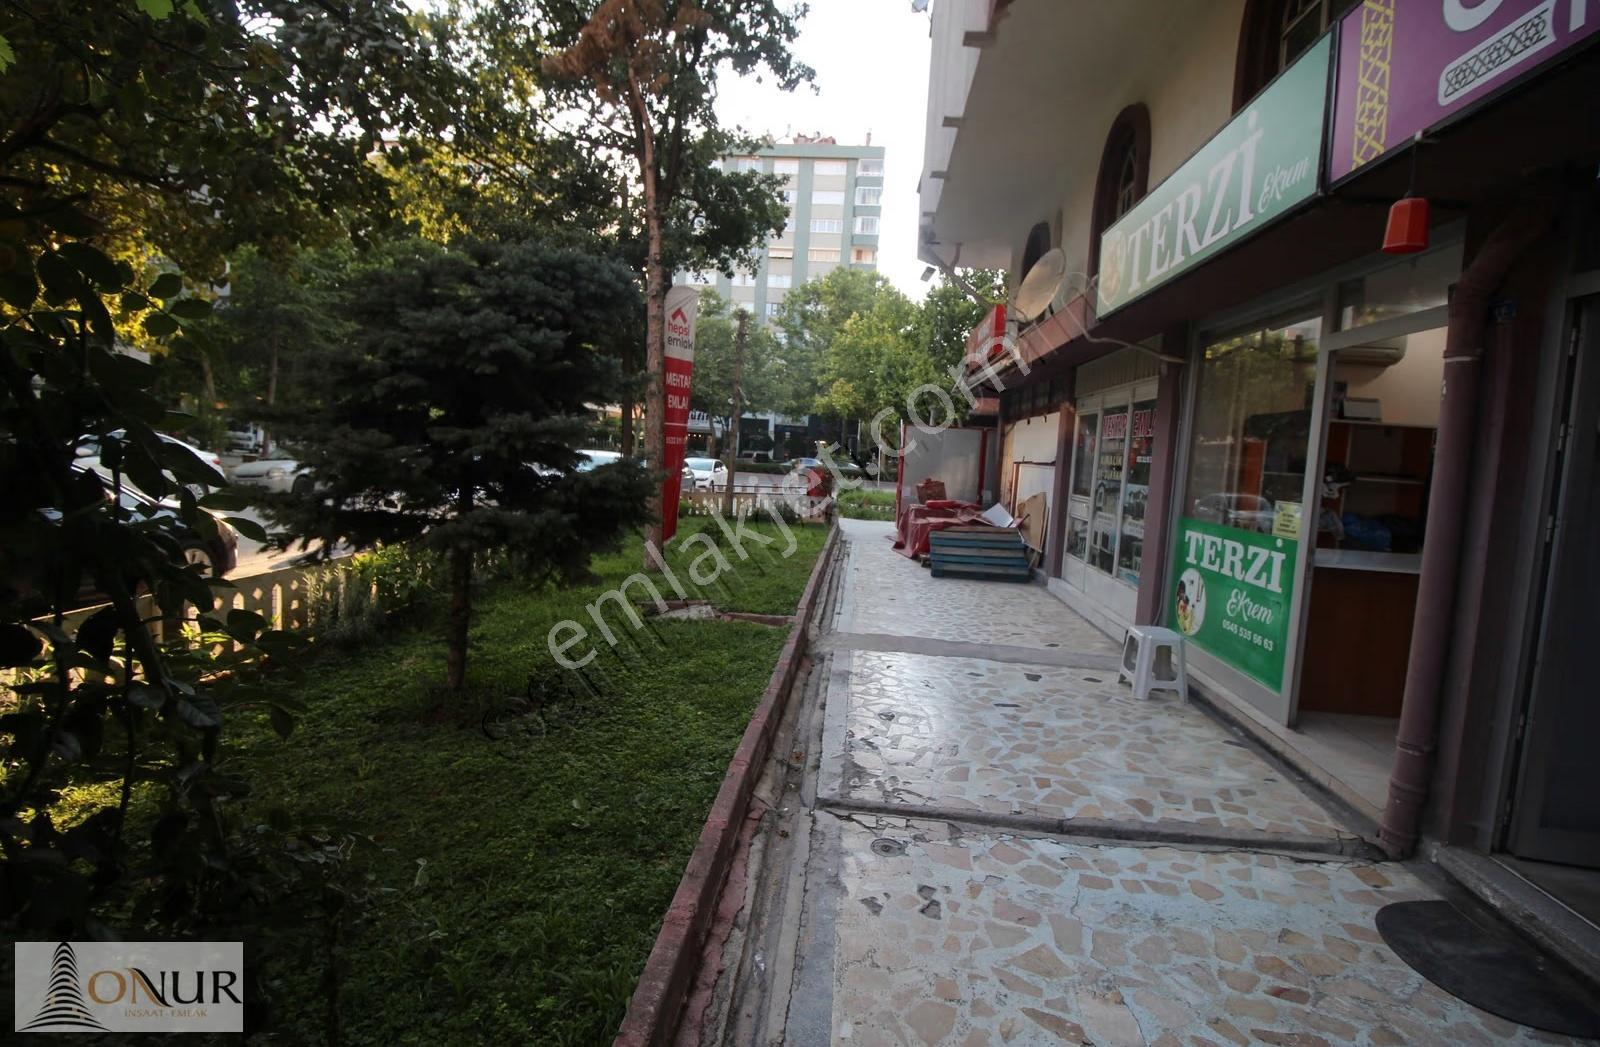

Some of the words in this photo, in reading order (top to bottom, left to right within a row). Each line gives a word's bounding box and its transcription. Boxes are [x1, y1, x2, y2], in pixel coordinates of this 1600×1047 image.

[667, 320, 690, 337] hepsi
[667, 334, 693, 350] emlak
[1185, 530, 1286, 593] TERZİ
[1226, 588, 1274, 625] Ekrem
